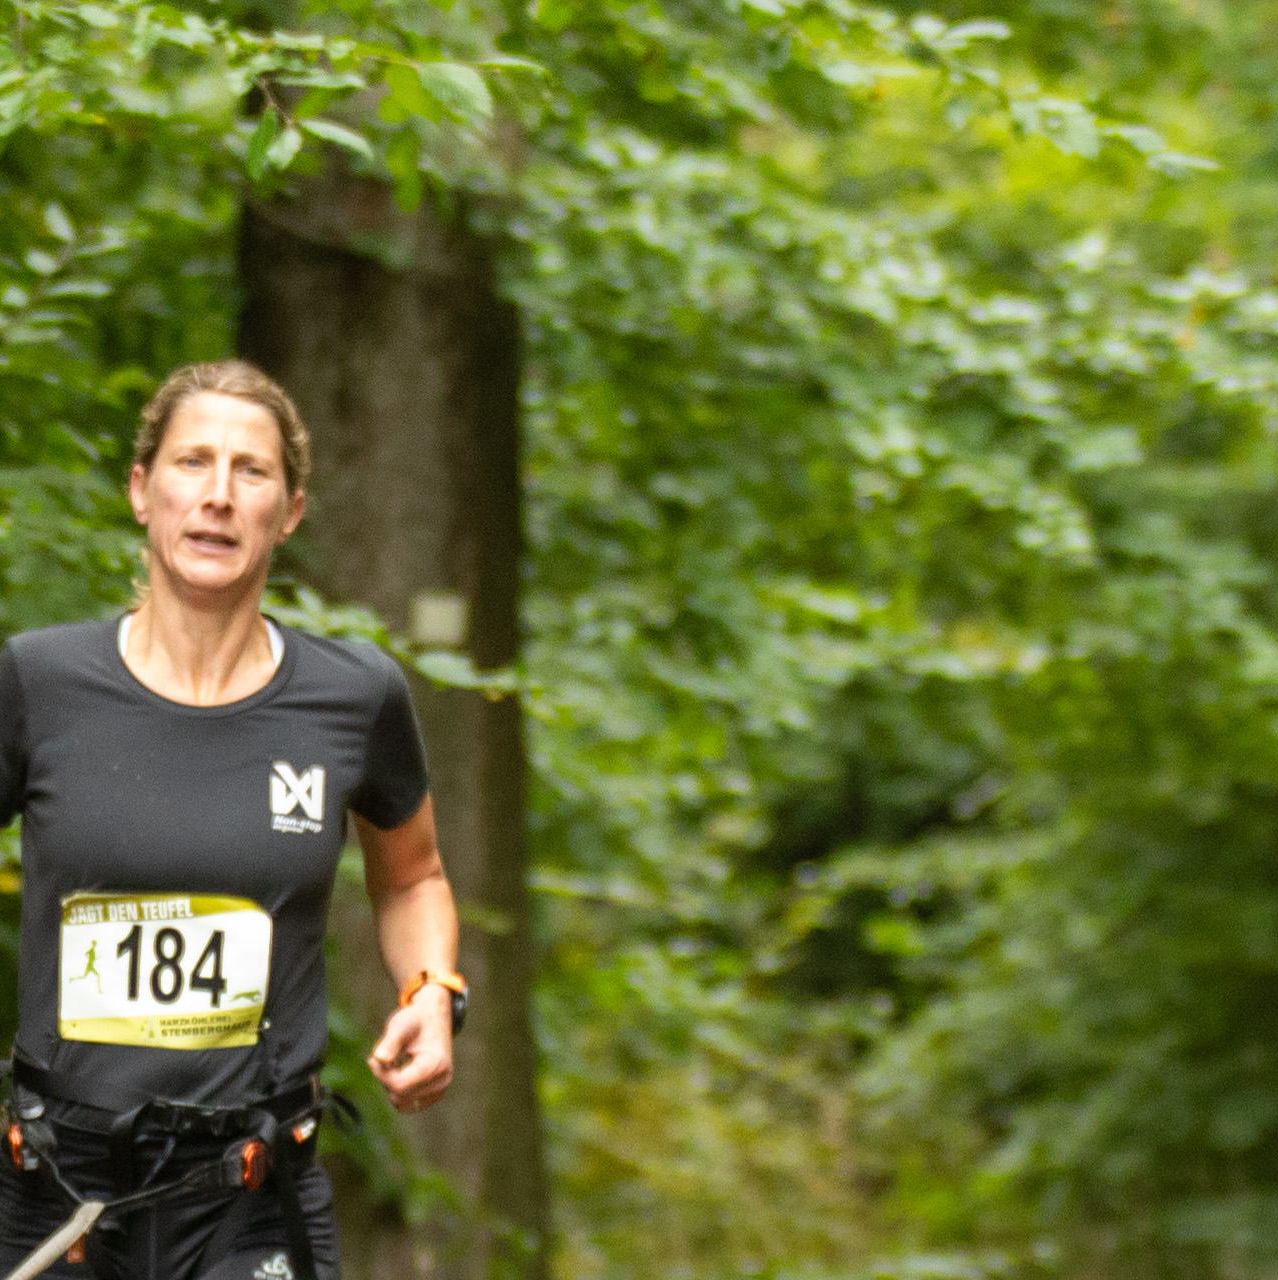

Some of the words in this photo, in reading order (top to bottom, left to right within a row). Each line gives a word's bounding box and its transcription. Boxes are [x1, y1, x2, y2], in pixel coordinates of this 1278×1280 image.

[69, 904, 104, 924] JAGT
[108, 902, 138, 921] DEN
[142, 899, 193, 921] TEUFEL
[116, 924, 228, 1009] 184
